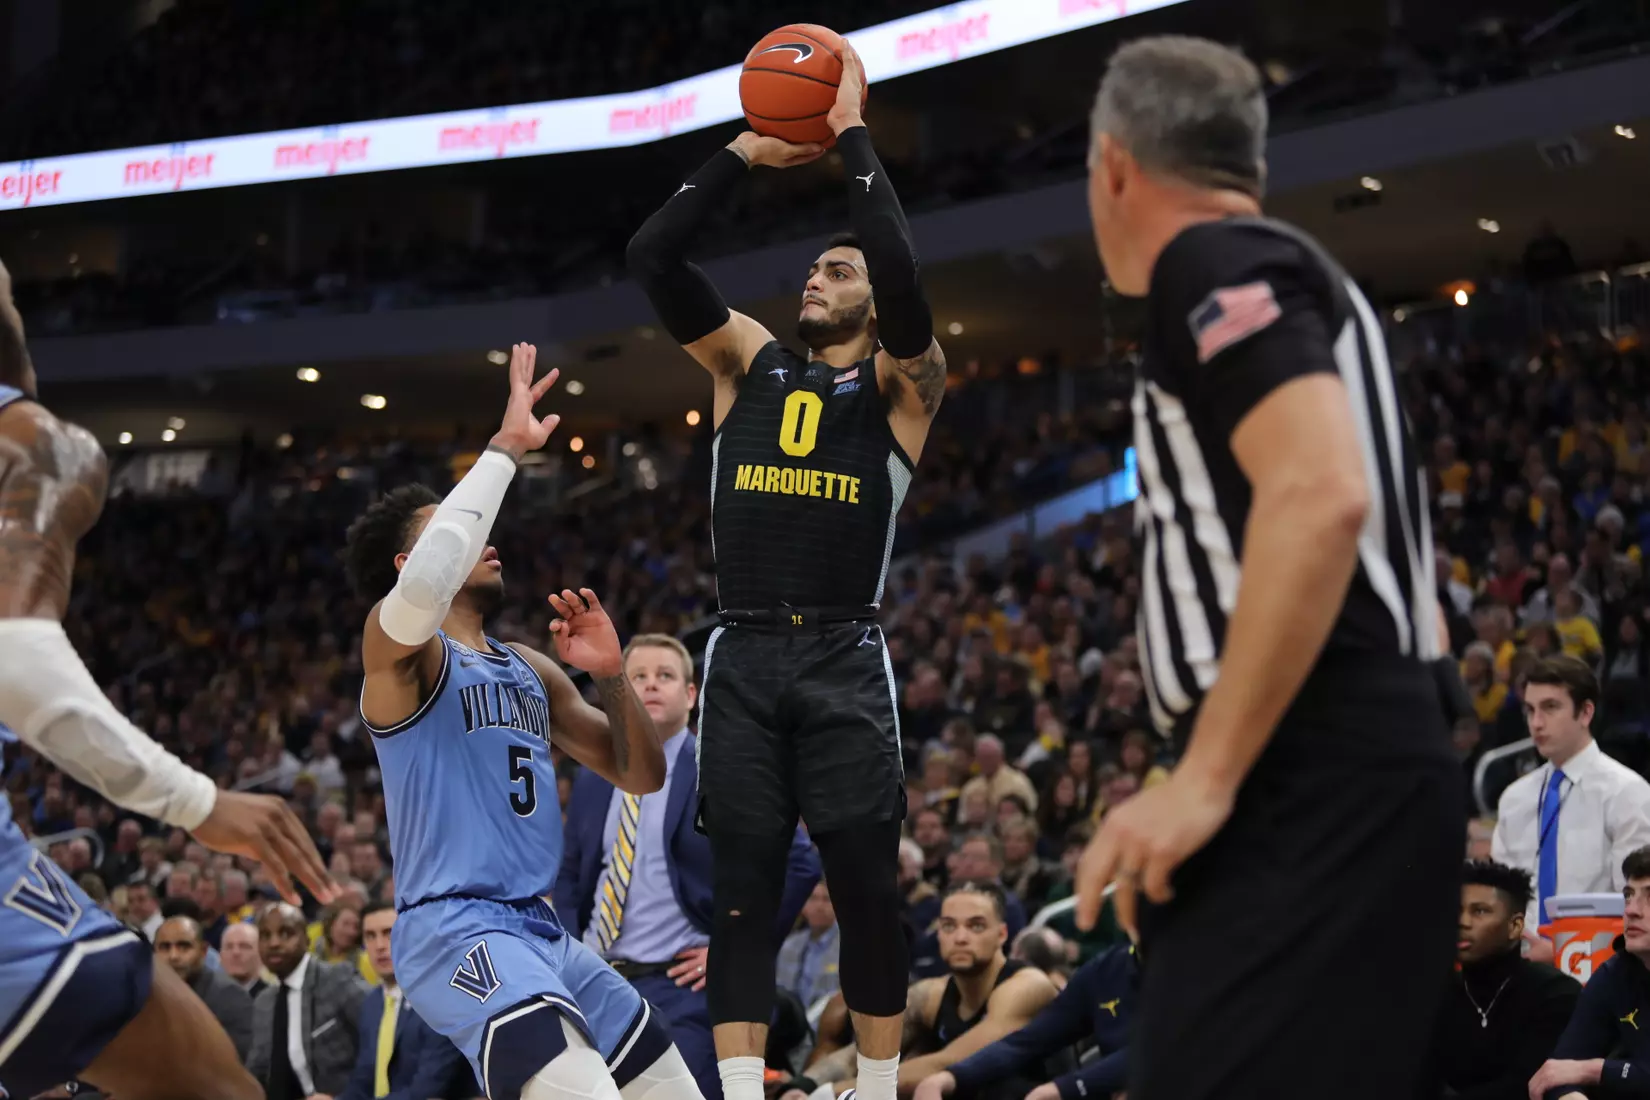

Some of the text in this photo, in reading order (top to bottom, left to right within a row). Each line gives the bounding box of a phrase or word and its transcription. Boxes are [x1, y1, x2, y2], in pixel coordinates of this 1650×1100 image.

[123, 142, 216, 191] meijer
[273, 125, 371, 176] meijer
[0, 160, 63, 208] eijer
[778, 389, 824, 458] 0
[734, 464, 861, 505] MARQUETTE
[458, 682, 551, 749] VILLANOV
[508, 744, 538, 818] 5
[1559, 939, 1593, 986] G
